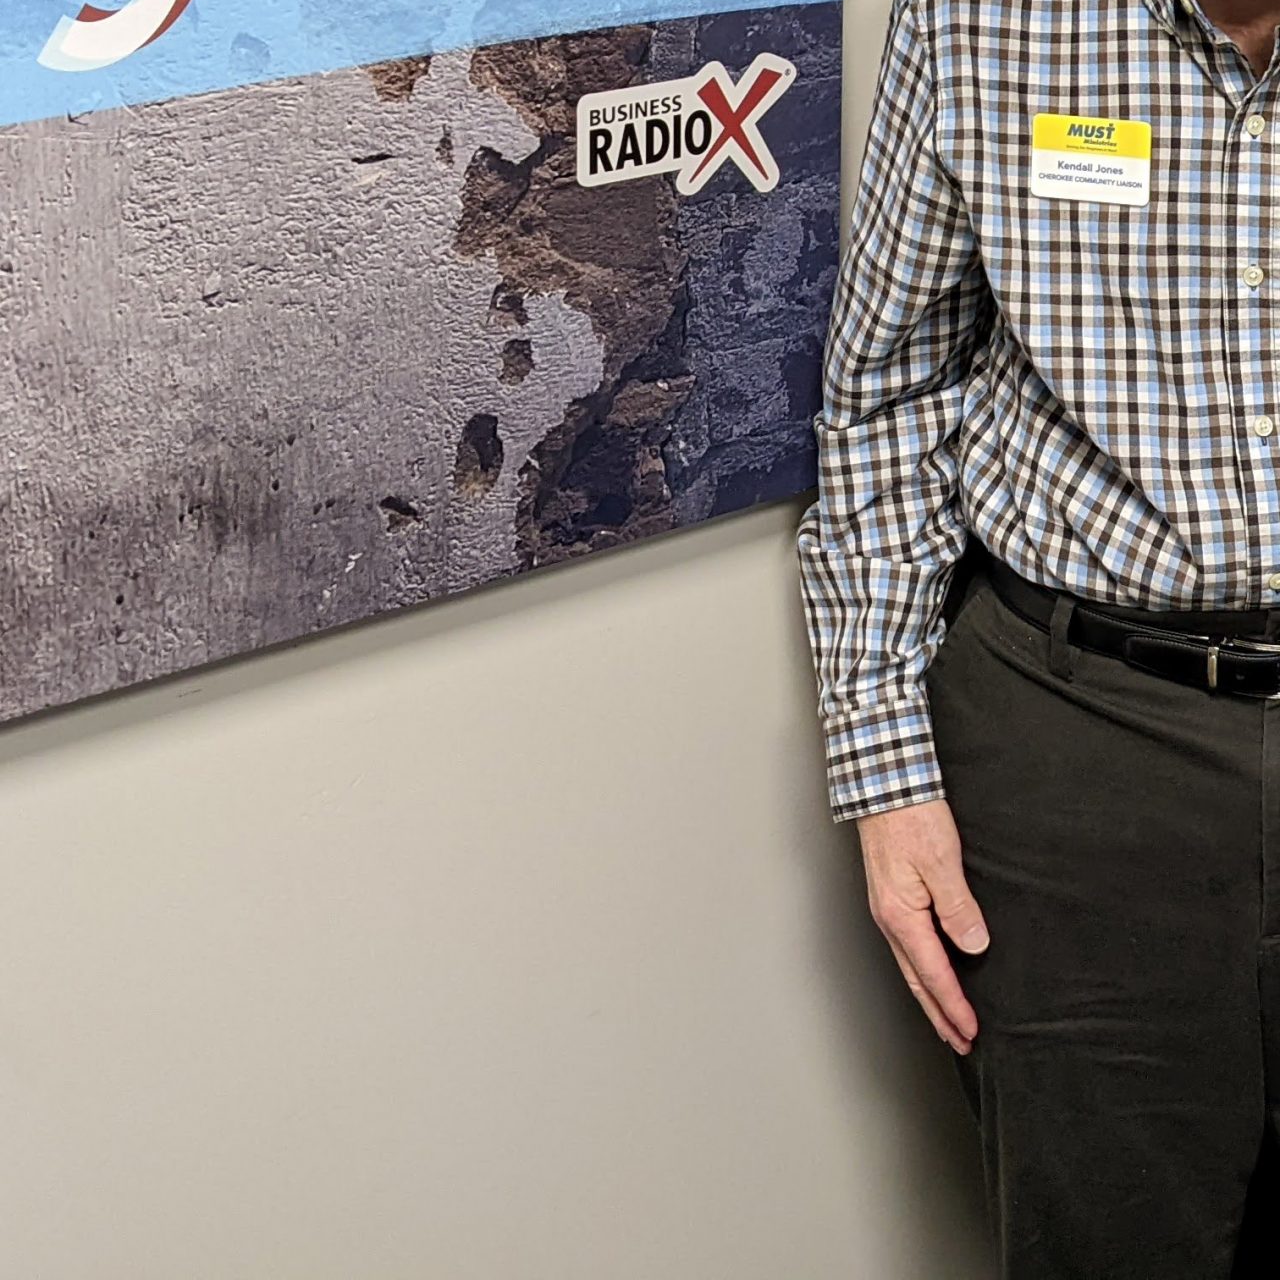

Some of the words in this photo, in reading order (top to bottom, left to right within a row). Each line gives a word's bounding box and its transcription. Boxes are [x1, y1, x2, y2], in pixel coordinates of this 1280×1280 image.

[589, 94, 682, 126] BUSINESS
[1067, 123, 1115, 139] MUST
[1057, 160, 1093, 173] Kendall
[1095, 164, 1124, 175] Jones
[1038, 172, 1073, 182] CHEROKEE
[1074, 176, 1116, 186] COMMUNITY
[1116, 180, 1142, 188] LIAISON
